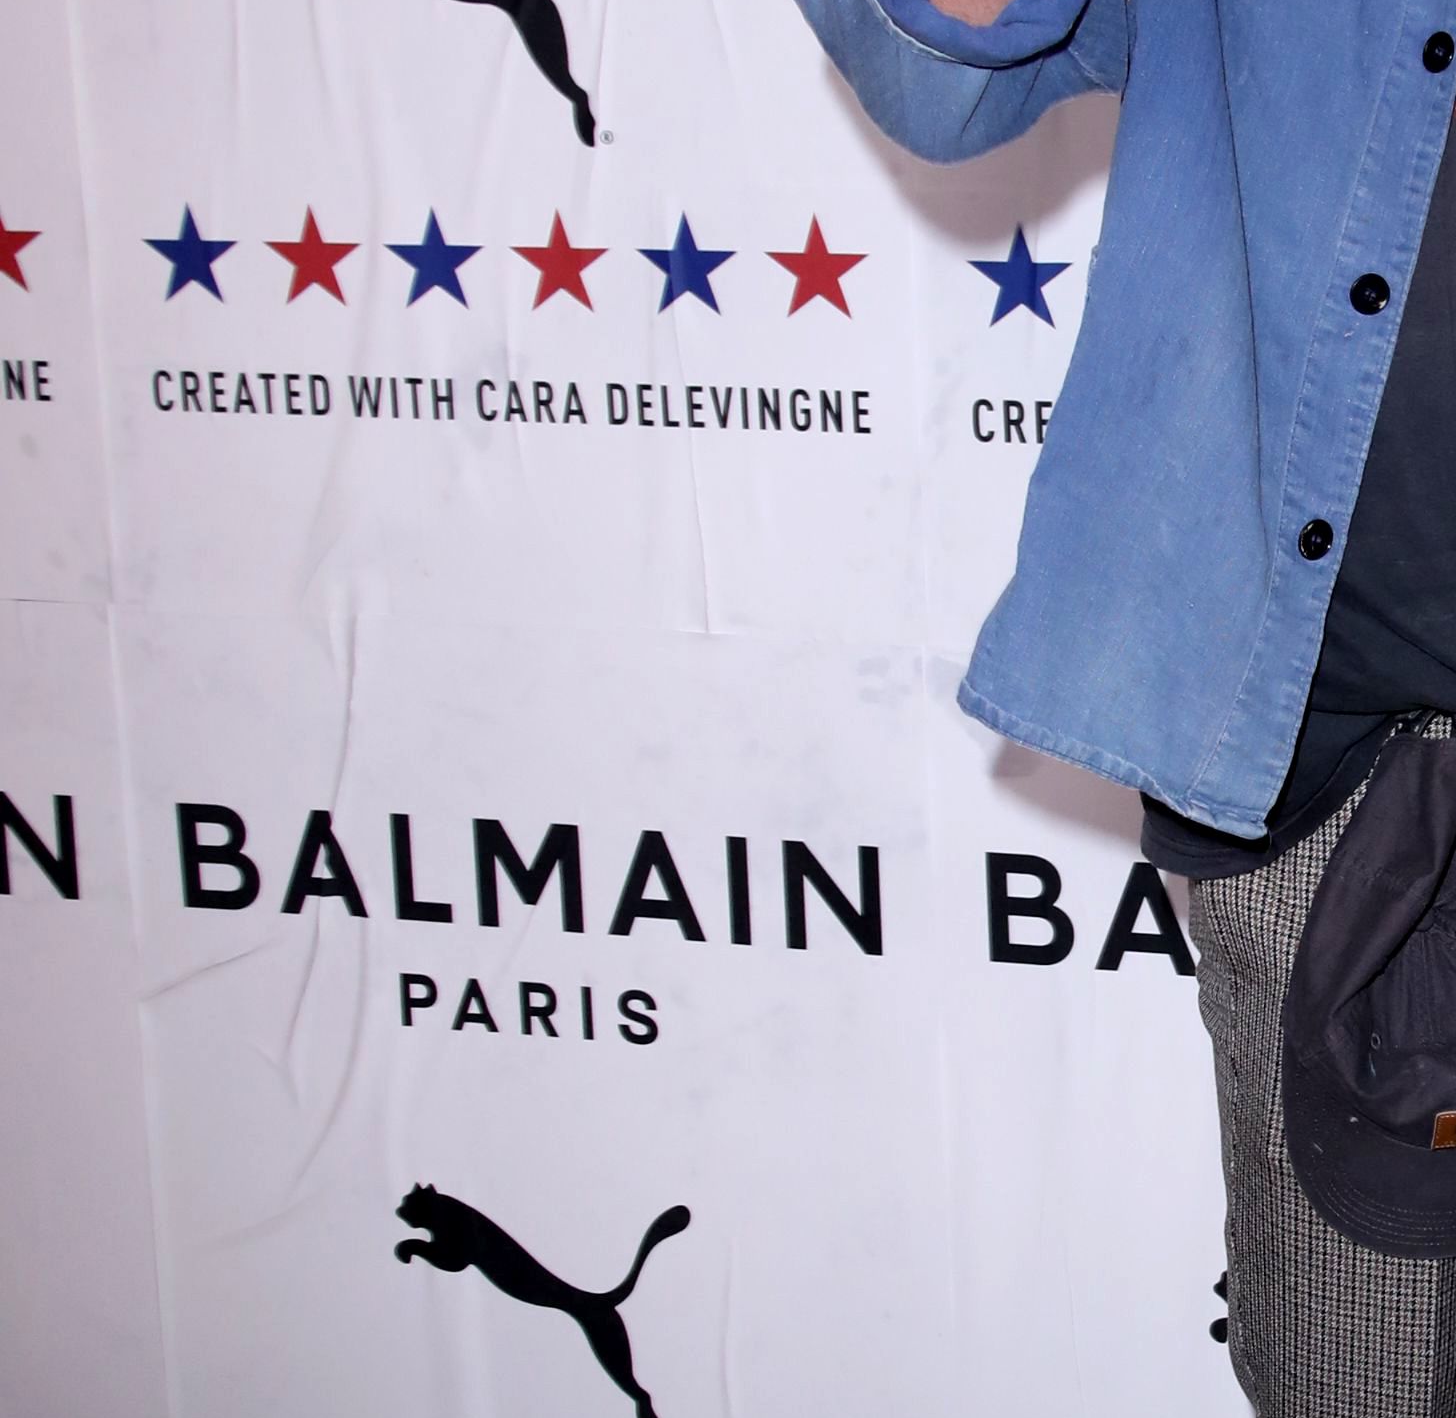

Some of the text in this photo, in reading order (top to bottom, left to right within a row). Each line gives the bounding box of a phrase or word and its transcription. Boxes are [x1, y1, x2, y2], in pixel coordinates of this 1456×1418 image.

[4, 360, 52, 402] NE
[153, 370, 871, 434] CREATED WITH CARA DELEVINGNE
[175, 802, 883, 956] BALMAIN
[985, 851, 1197, 977] BA
[399, 973, 659, 1046] PARIS
